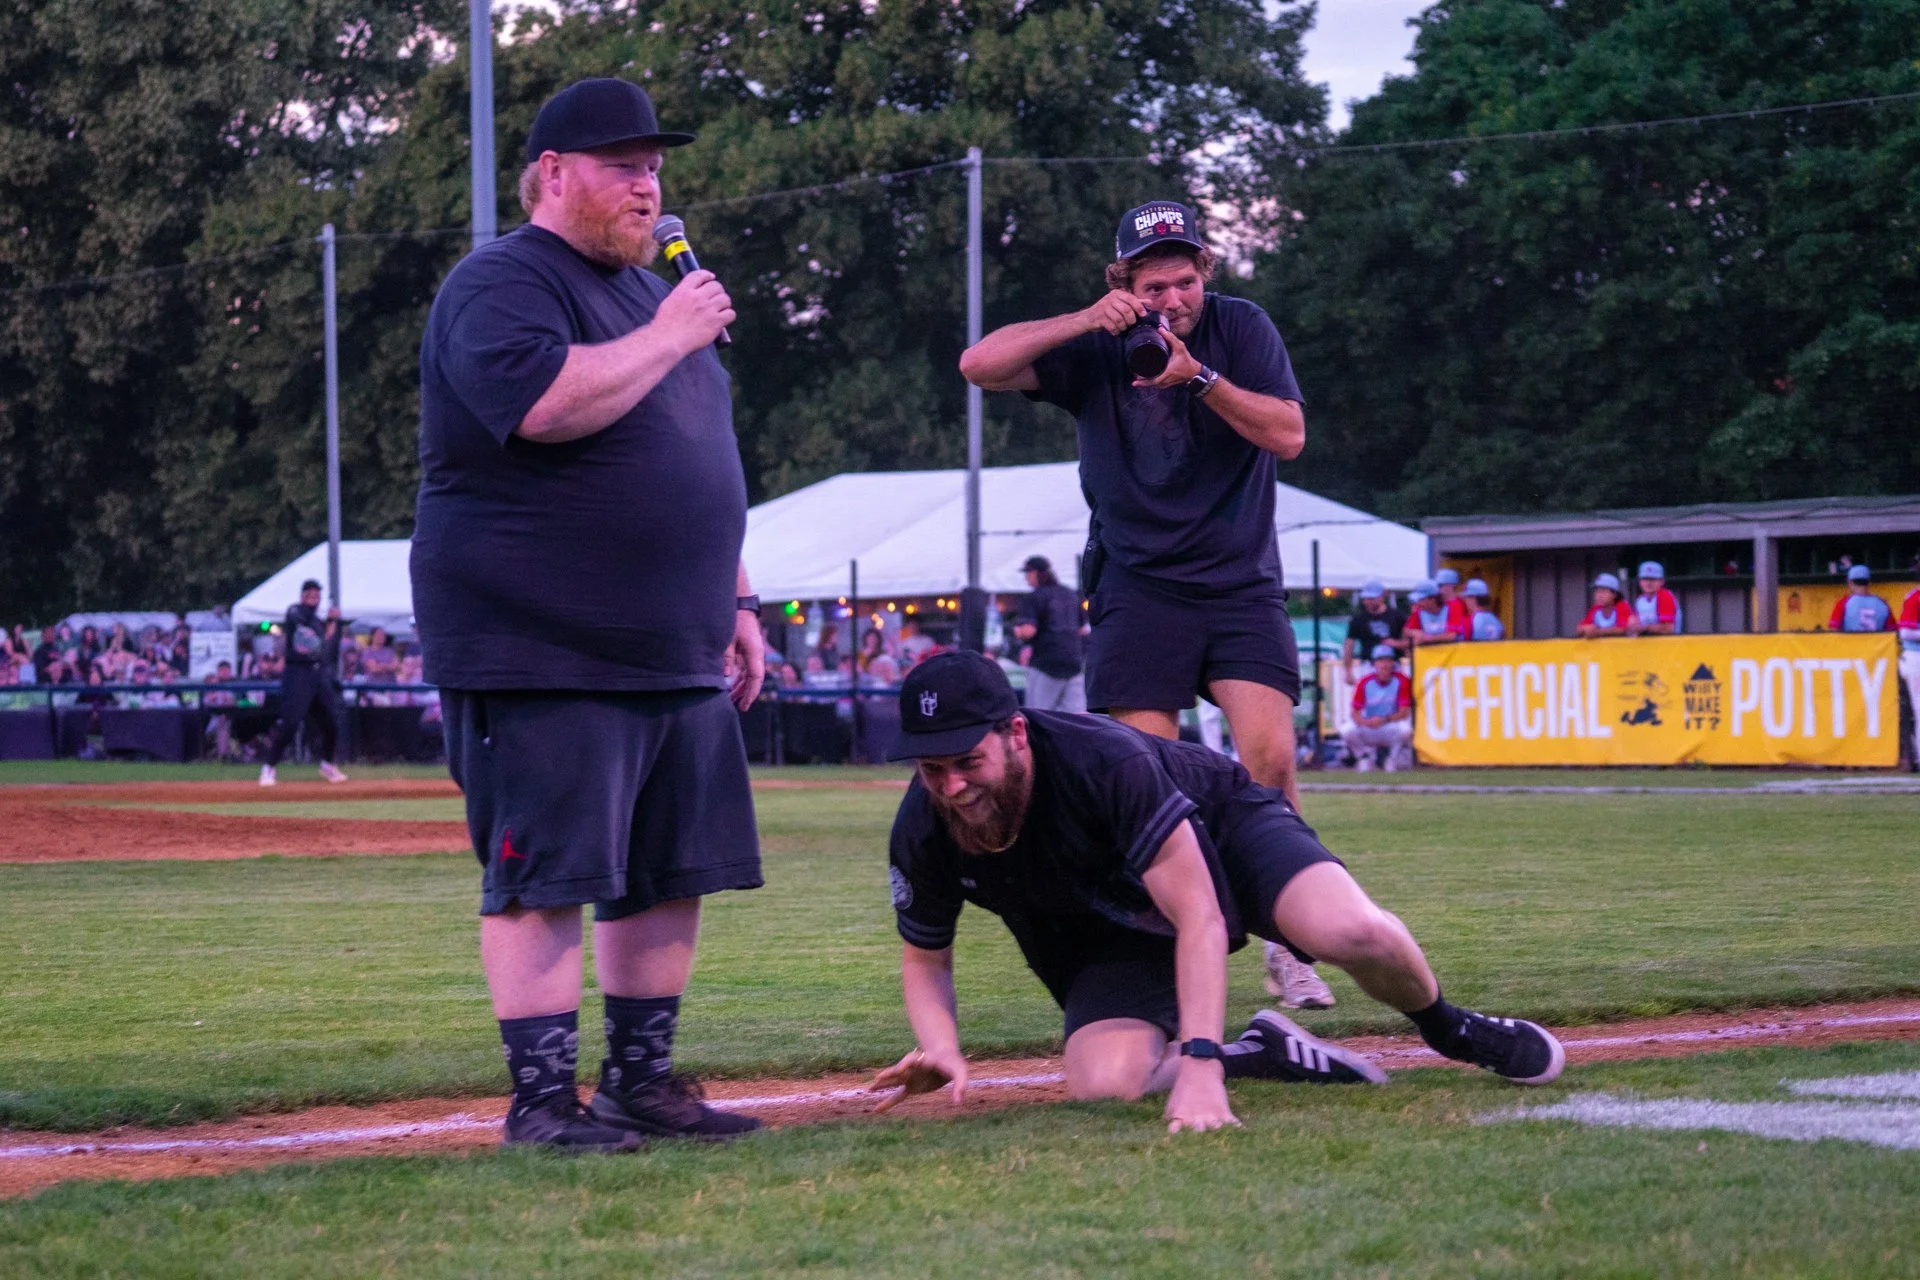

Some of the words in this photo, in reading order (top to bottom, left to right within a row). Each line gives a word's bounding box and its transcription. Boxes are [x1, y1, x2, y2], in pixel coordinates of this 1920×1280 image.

[1140, 206, 1175, 215] NATIONAL
[1134, 211, 1185, 231] CHAMPS
[1423, 662, 1612, 740] OFFICIAL
[1731, 656, 1888, 738] POTTY
[1685, 697, 1721, 714] MAKE
[1685, 717, 1721, 731] IT?
